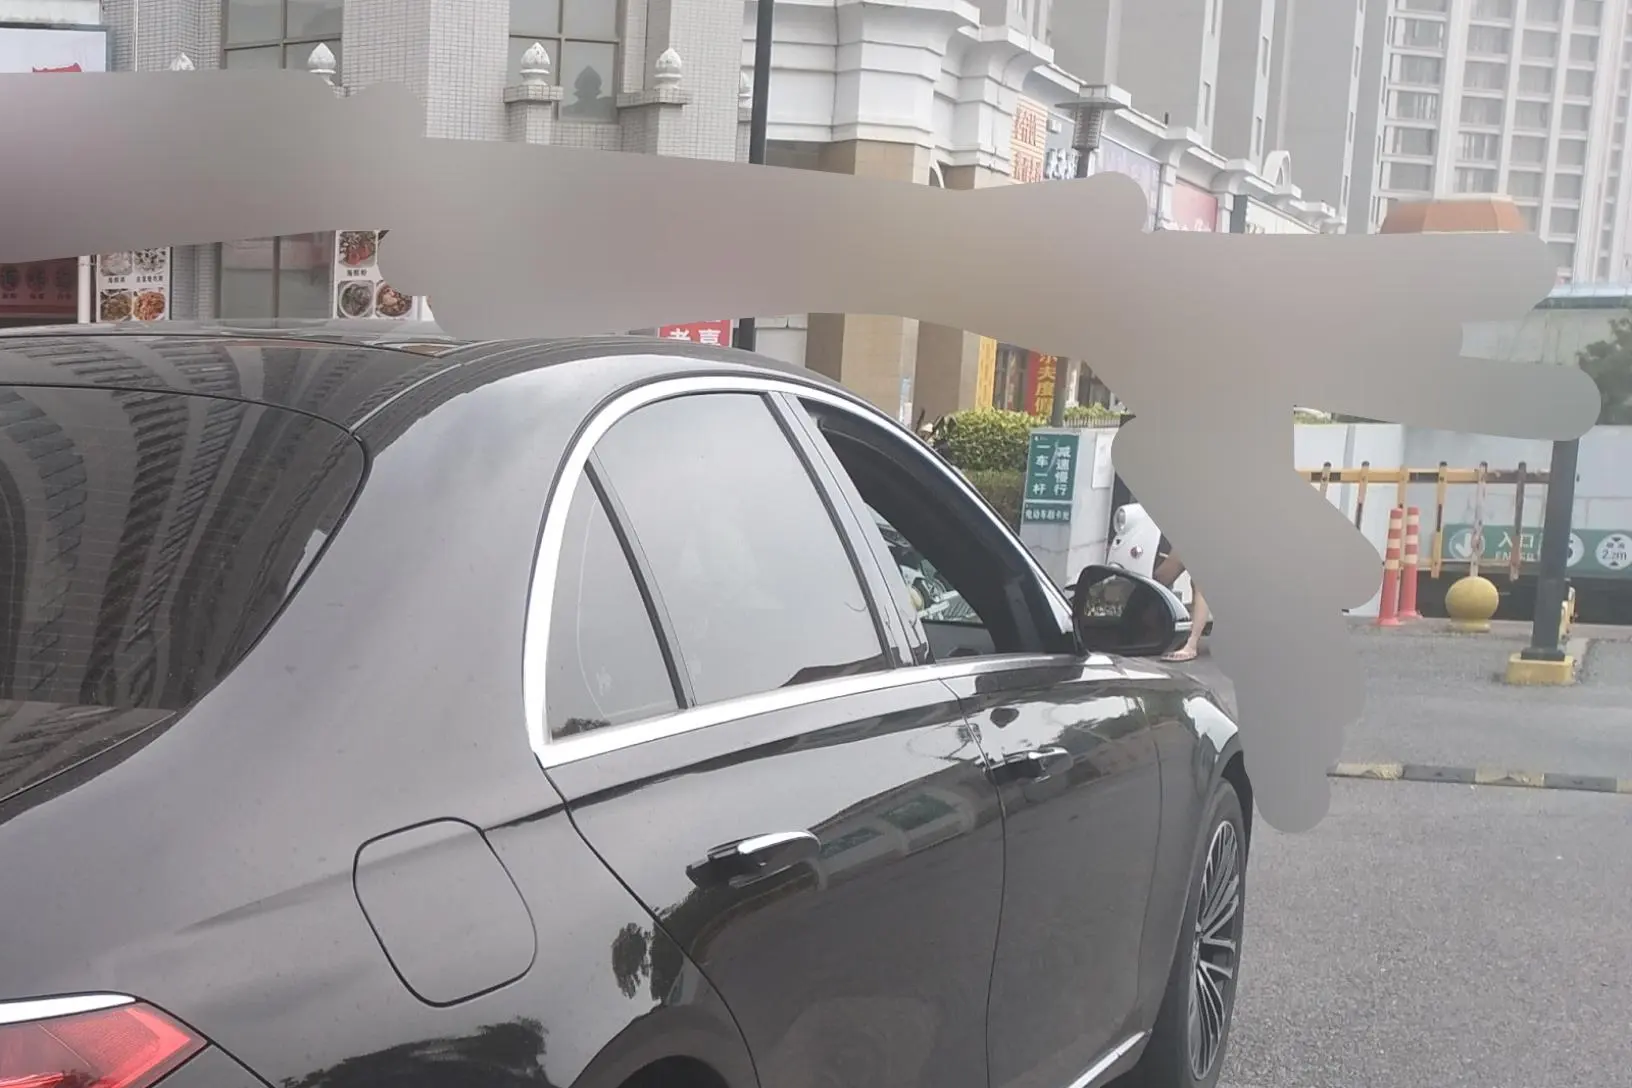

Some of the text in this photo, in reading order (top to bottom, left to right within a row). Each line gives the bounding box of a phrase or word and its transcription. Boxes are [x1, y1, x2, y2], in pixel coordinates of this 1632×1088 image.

[1032, 443, 1051, 496] 一车一杆
[1053, 445, 1071, 497] 减速慢行
[1498, 531, 1535, 549] 入口
